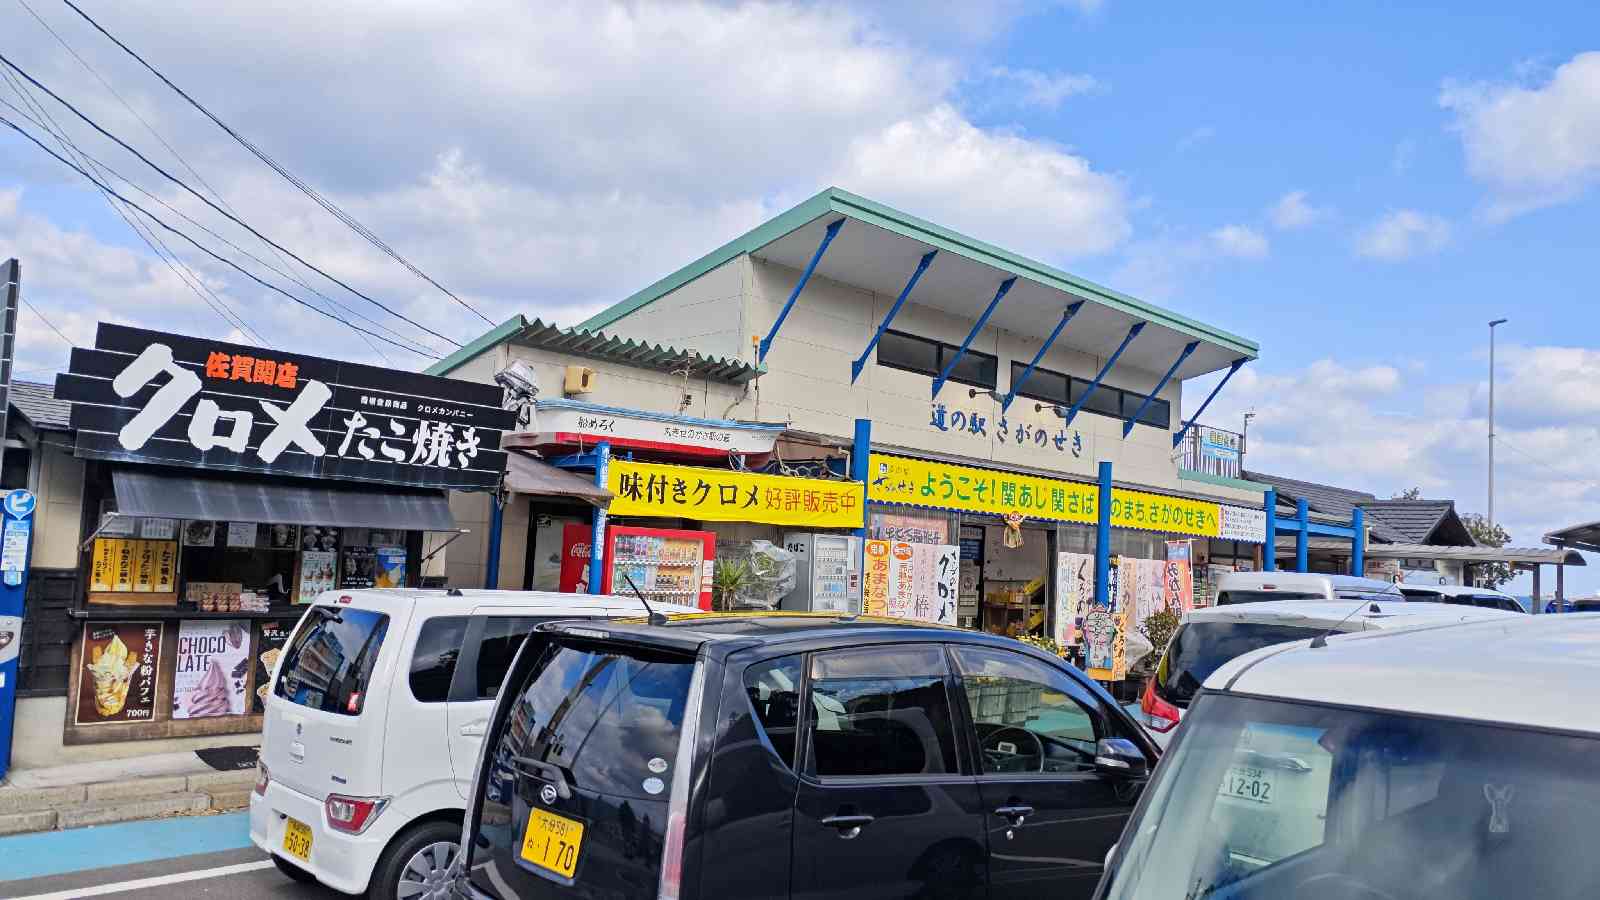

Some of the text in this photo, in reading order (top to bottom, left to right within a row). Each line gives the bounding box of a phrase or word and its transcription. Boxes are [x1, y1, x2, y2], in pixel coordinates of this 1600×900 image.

[206, 352, 299, 389] 佐賀関店
[112, 342, 333, 464] クロメ
[417, 404, 474, 418] クロメカンパニー
[338, 411, 481, 469] たこ焼き
[929, 403, 1082, 458] 道の駅 さがのせき
[619, 471, 759, 509] 味付きクロメ
[765, 488, 857, 514] 好評販売中
[1001, 481, 1047, 509] 関あじ
[1051, 488, 1095, 515] 関さば
[177, 654, 211, 673] LATE
[178, 635, 226, 655] CHOCO
